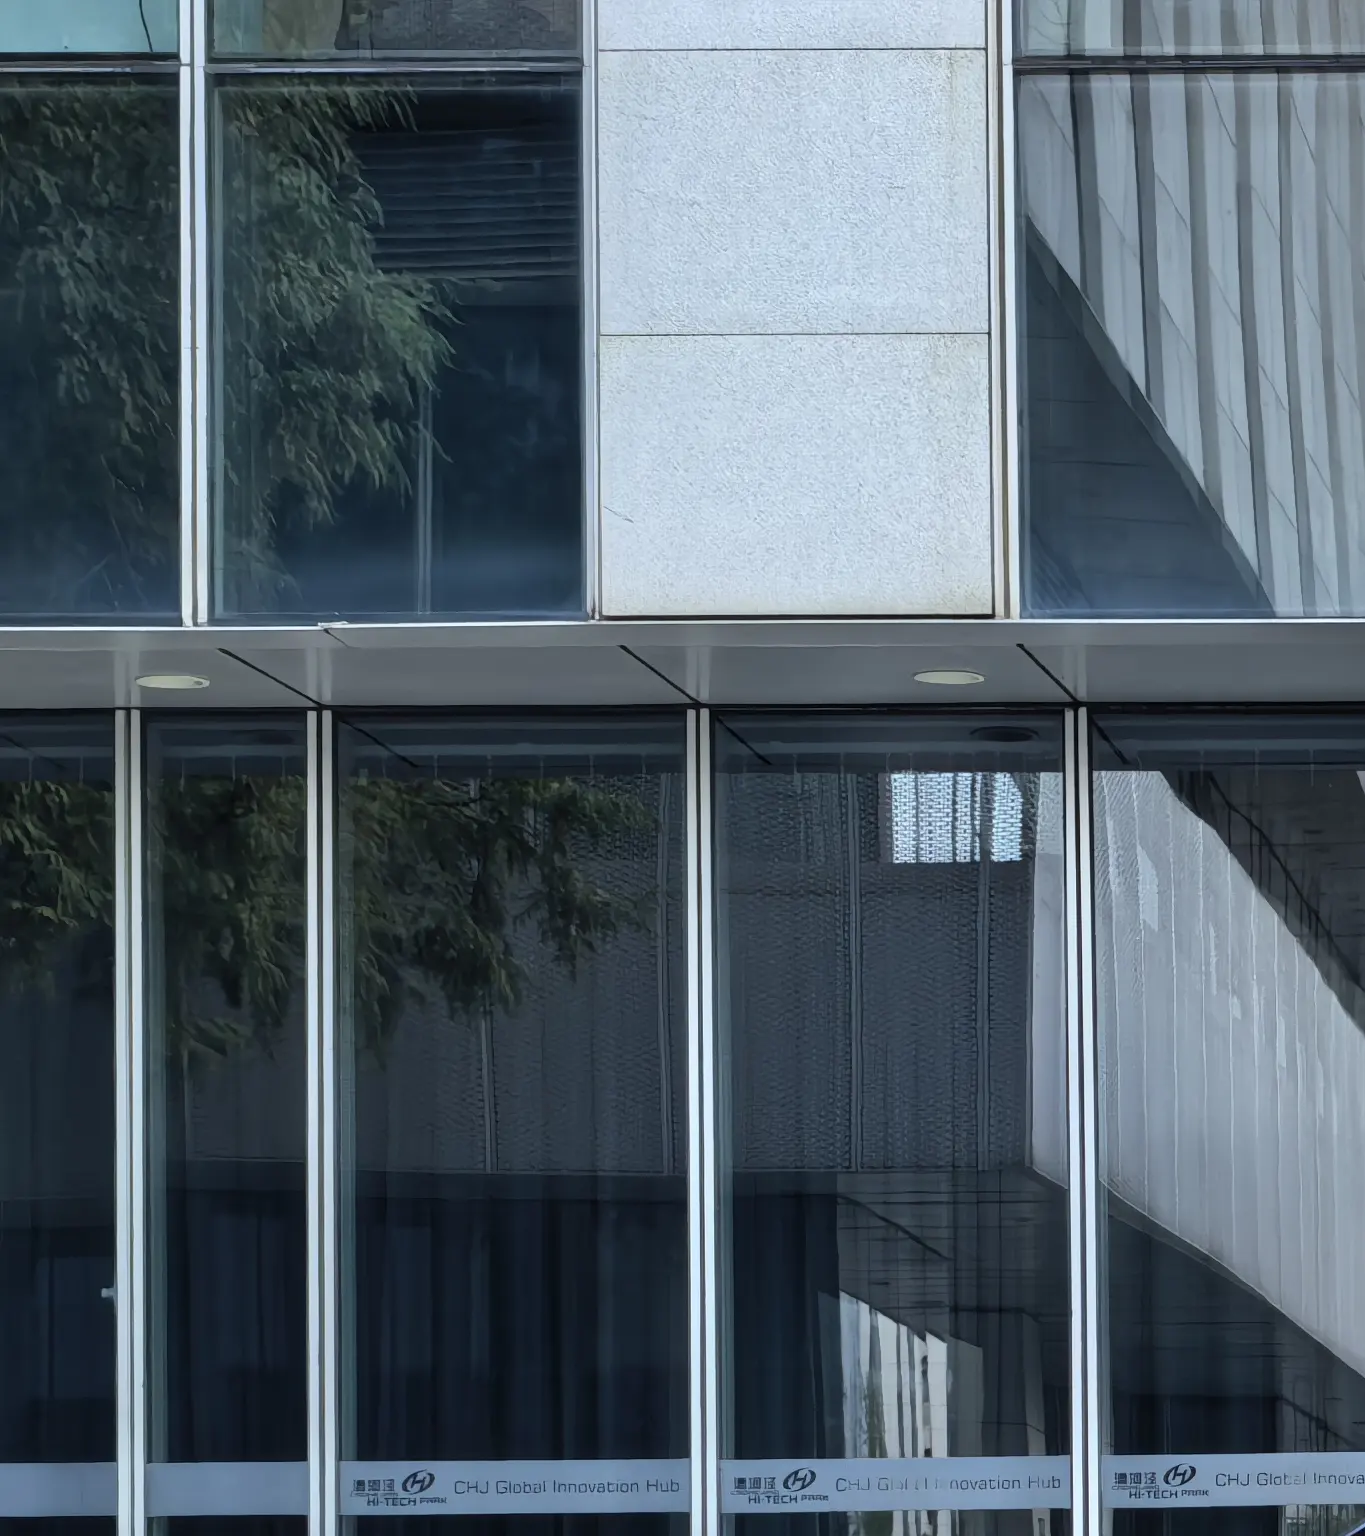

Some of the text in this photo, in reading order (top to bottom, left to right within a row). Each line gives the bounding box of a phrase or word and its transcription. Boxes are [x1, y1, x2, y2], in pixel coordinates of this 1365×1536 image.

[454, 1478, 680, 1495] CHJ Global Innovation Hub
[835, 1477, 870, 1492] CHJ
[1028, 1475, 1061, 1489] Hub
[1215, 1472, 1250, 1487] CHJ
[1256, 1472, 1306, 1486] Global
[748, 1494, 798, 1504] HI-TECH
[1129, 1489, 1178, 1499] HI-TECH
